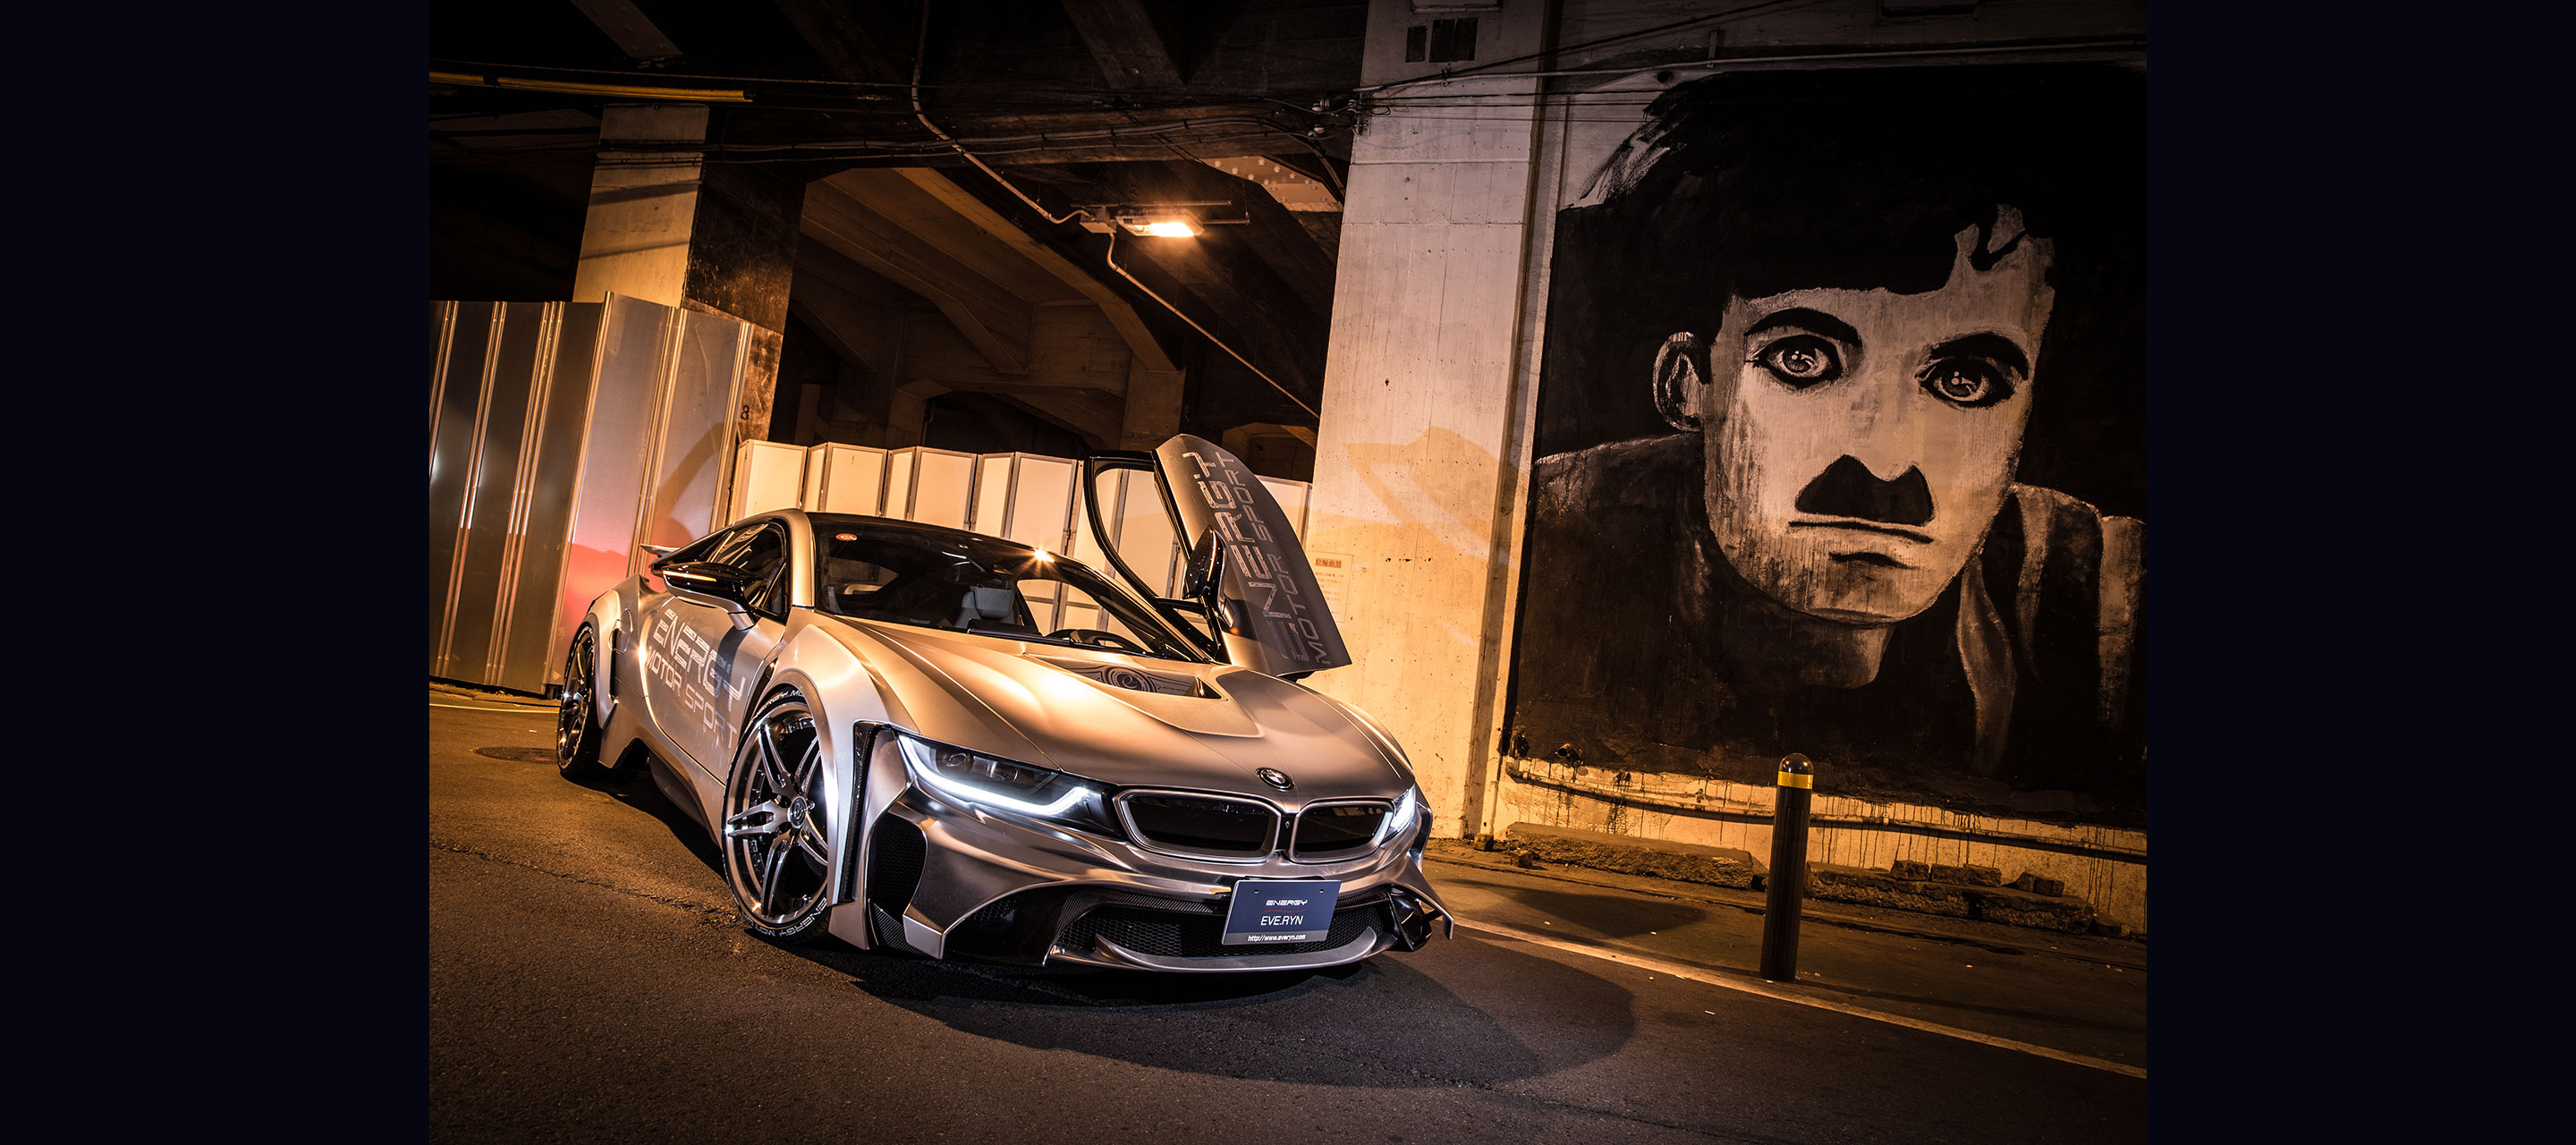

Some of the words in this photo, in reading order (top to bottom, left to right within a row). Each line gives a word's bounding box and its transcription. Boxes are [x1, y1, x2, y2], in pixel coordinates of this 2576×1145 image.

[1215, 451, 1274, 543] SPORT
[1182, 452, 1309, 662] ENERGY
[653, 608, 746, 712] ENERGY
[1267, 553, 1331, 665] MOTOR
[646, 646, 682, 697] MOTOR
[684, 683, 738, 749] SPORT
[778, 897, 827, 937] ENERGY
[1260, 915, 1303, 926] EVE.RYN
